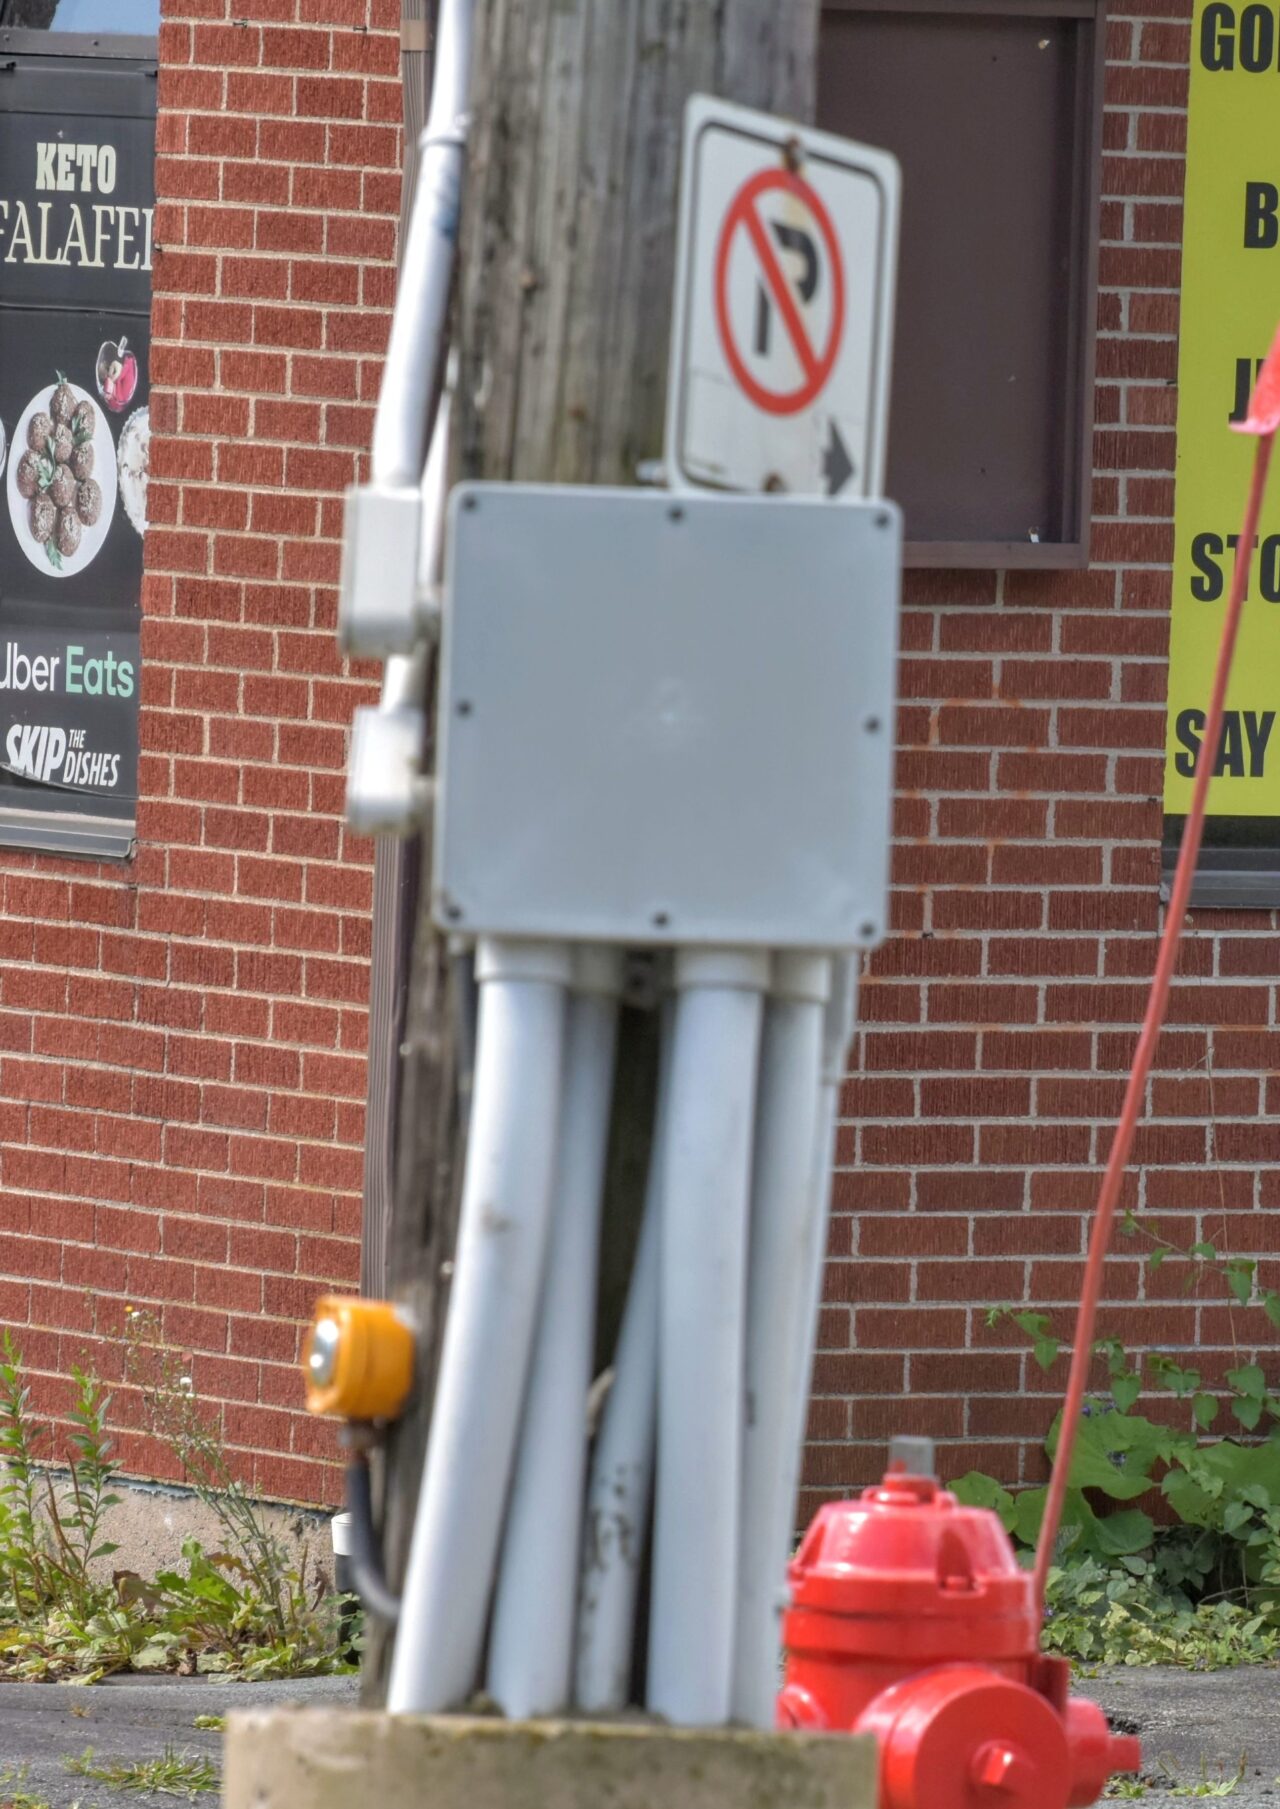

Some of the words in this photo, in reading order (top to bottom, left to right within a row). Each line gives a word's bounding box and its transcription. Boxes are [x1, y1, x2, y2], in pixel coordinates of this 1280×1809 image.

[35, 142, 117, 194] KETO
[65, 645, 134, 698] Eats
[6, 723, 67, 782] SKIP
[68, 729, 86, 749] THE
[1175, 708, 1276, 779] SAY
[62, 751, 121, 787] DISHES
